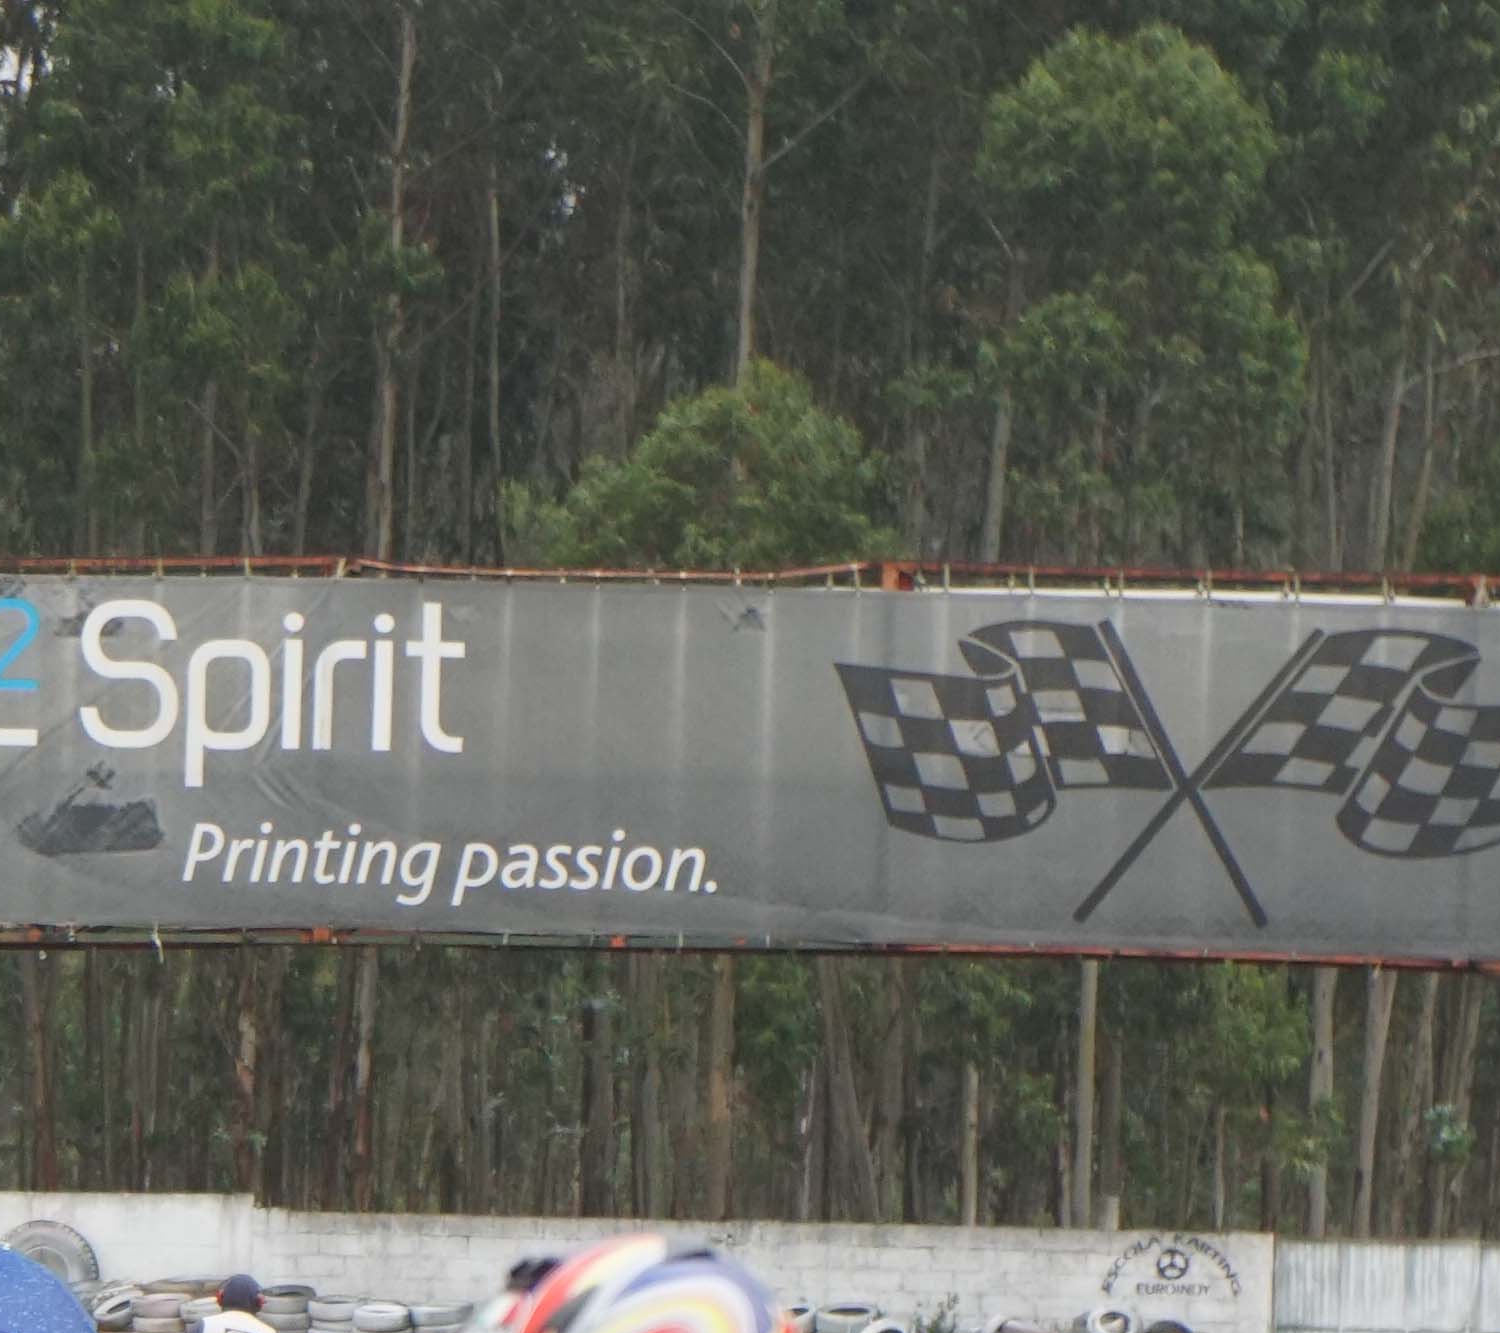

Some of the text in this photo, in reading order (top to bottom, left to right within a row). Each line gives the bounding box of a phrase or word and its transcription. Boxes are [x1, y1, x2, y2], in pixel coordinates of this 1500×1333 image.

[78, 598, 467, 789] Spirit
[181, 819, 720, 908] Printing passion.
